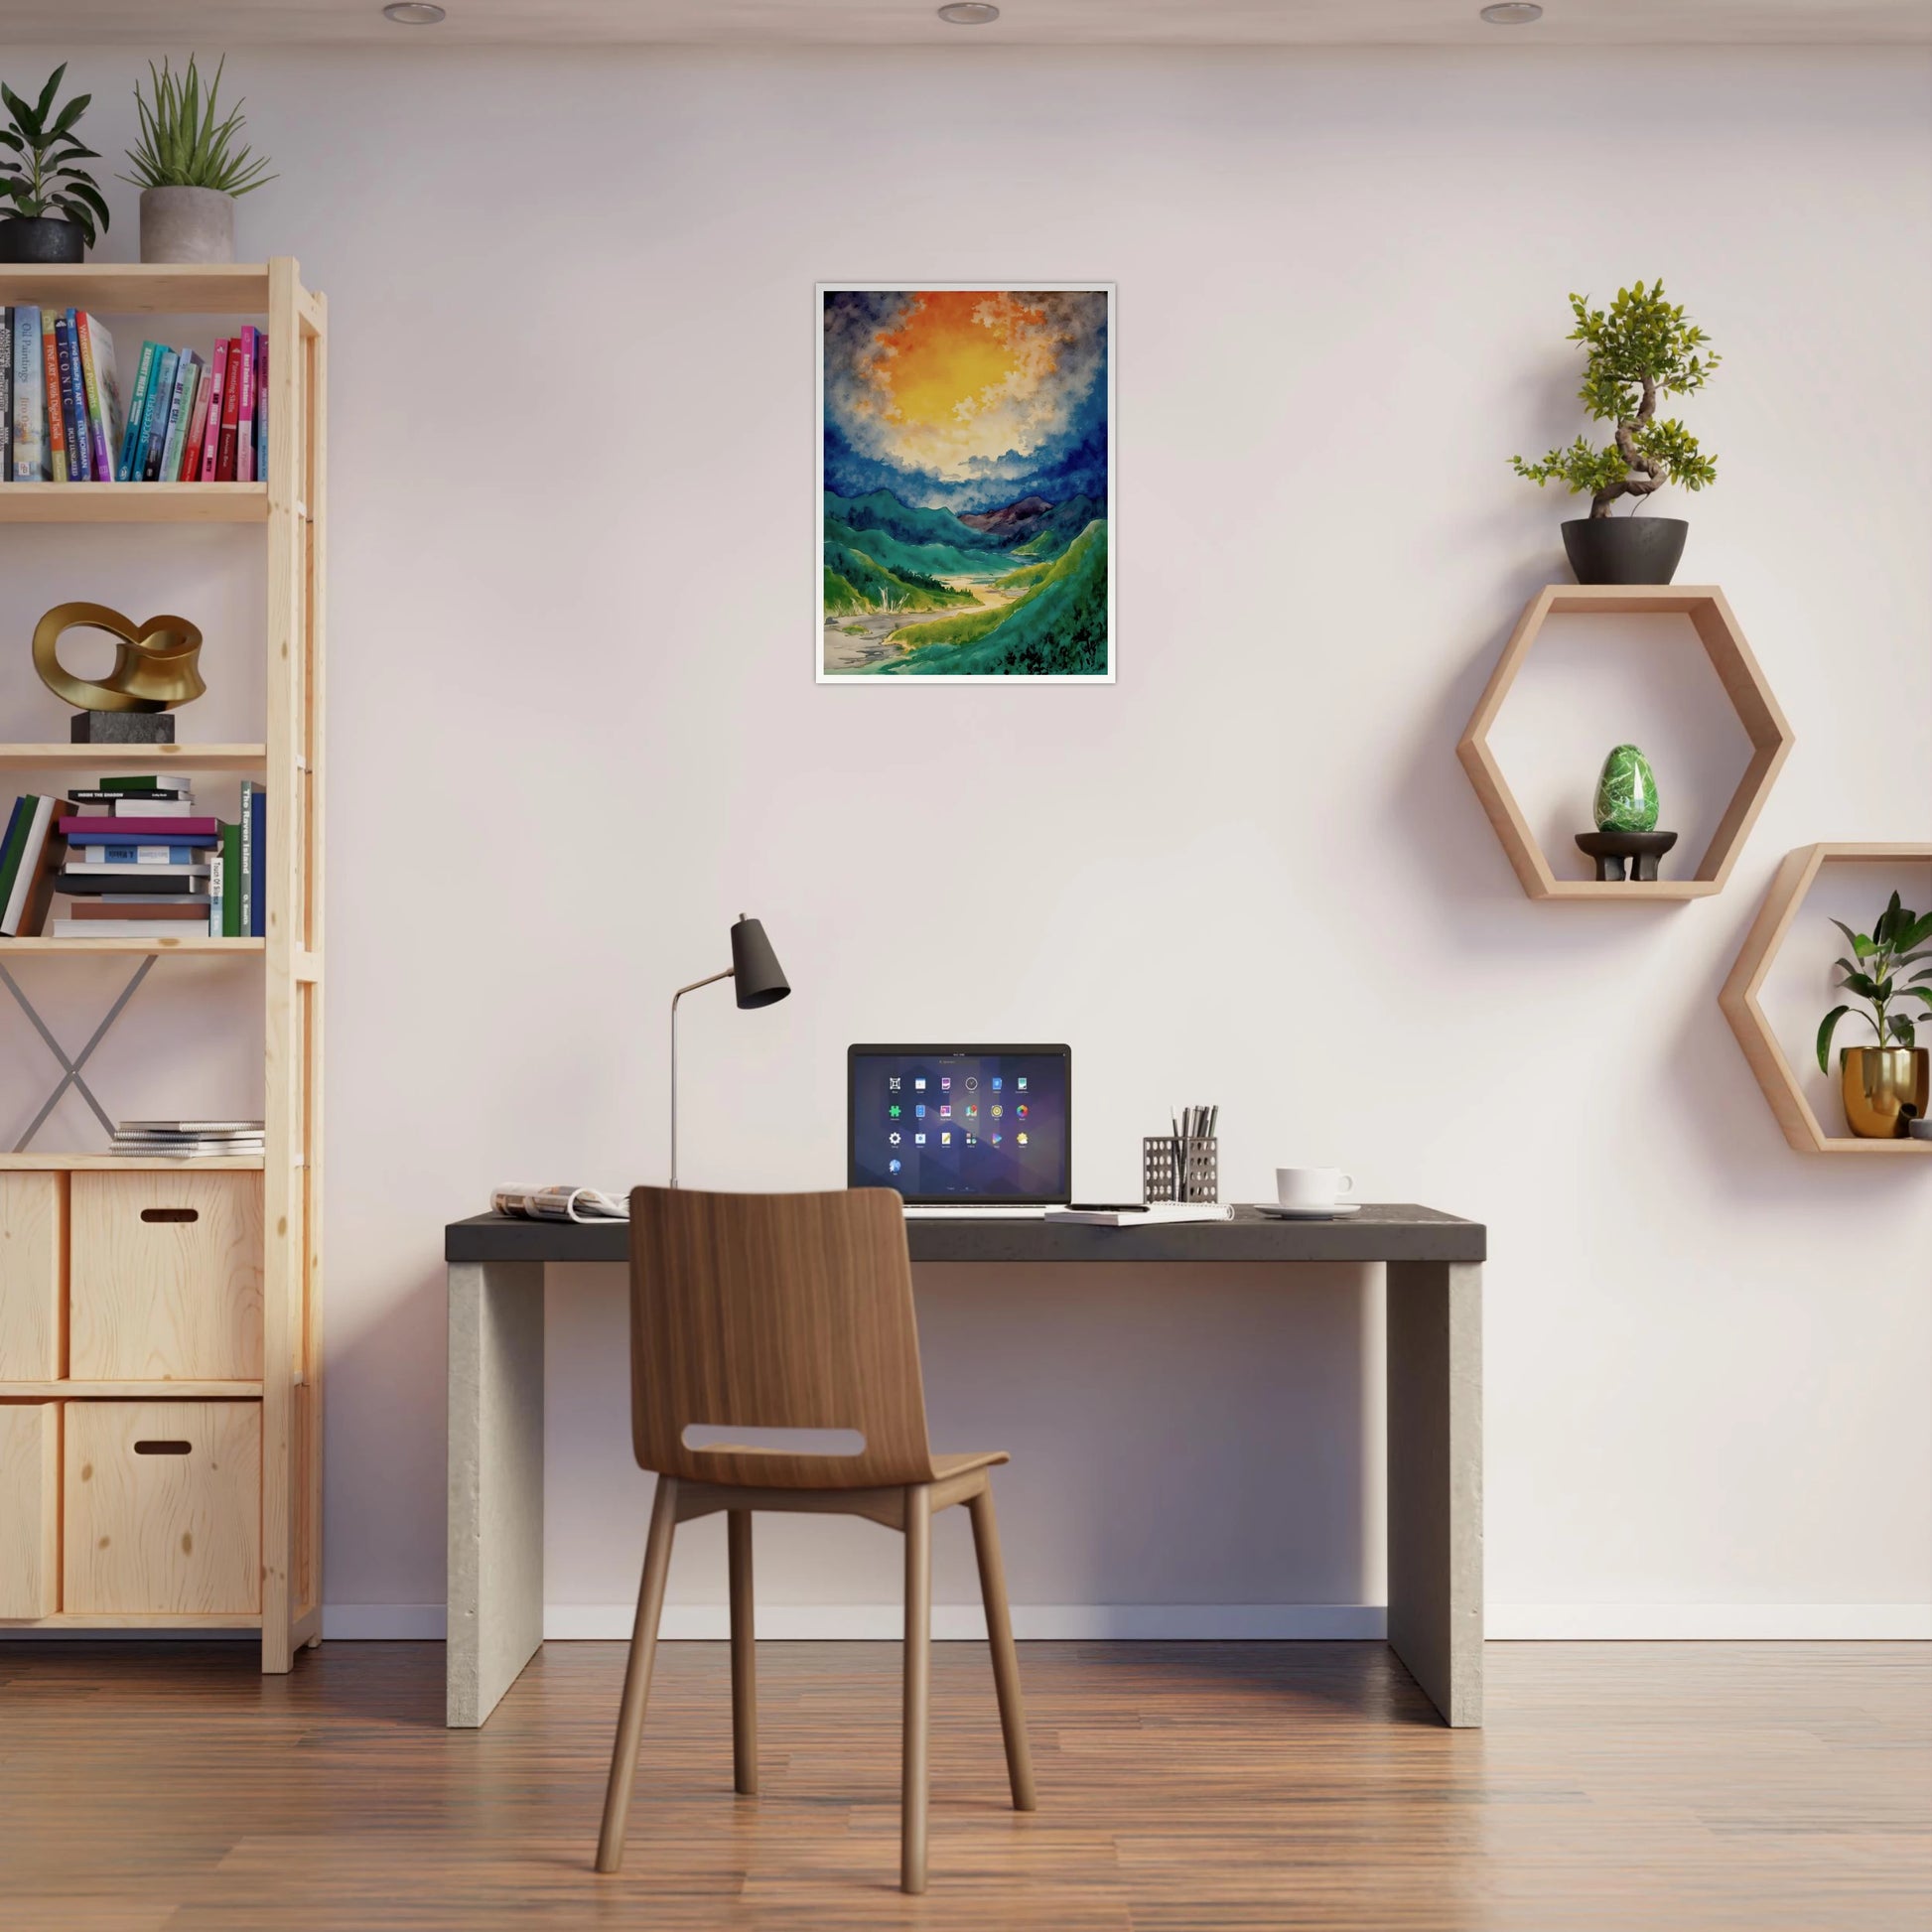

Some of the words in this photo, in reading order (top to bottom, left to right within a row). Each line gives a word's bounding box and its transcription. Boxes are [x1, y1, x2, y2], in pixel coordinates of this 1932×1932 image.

[22, 323, 32, 338] Oil
[18, 340, 31, 383] Paintings
[79, 324, 91, 371] Watercolor
[86, 372, 97, 408] Portraits
[228, 360, 239, 393] Parenting
[50, 382, 59, 399] With
[227, 394, 236, 413] Skills
[49, 400, 60, 421] Digital
[142, 393, 157, 443] SUCCESSFUL
[78, 437, 88, 469] NORMAN
